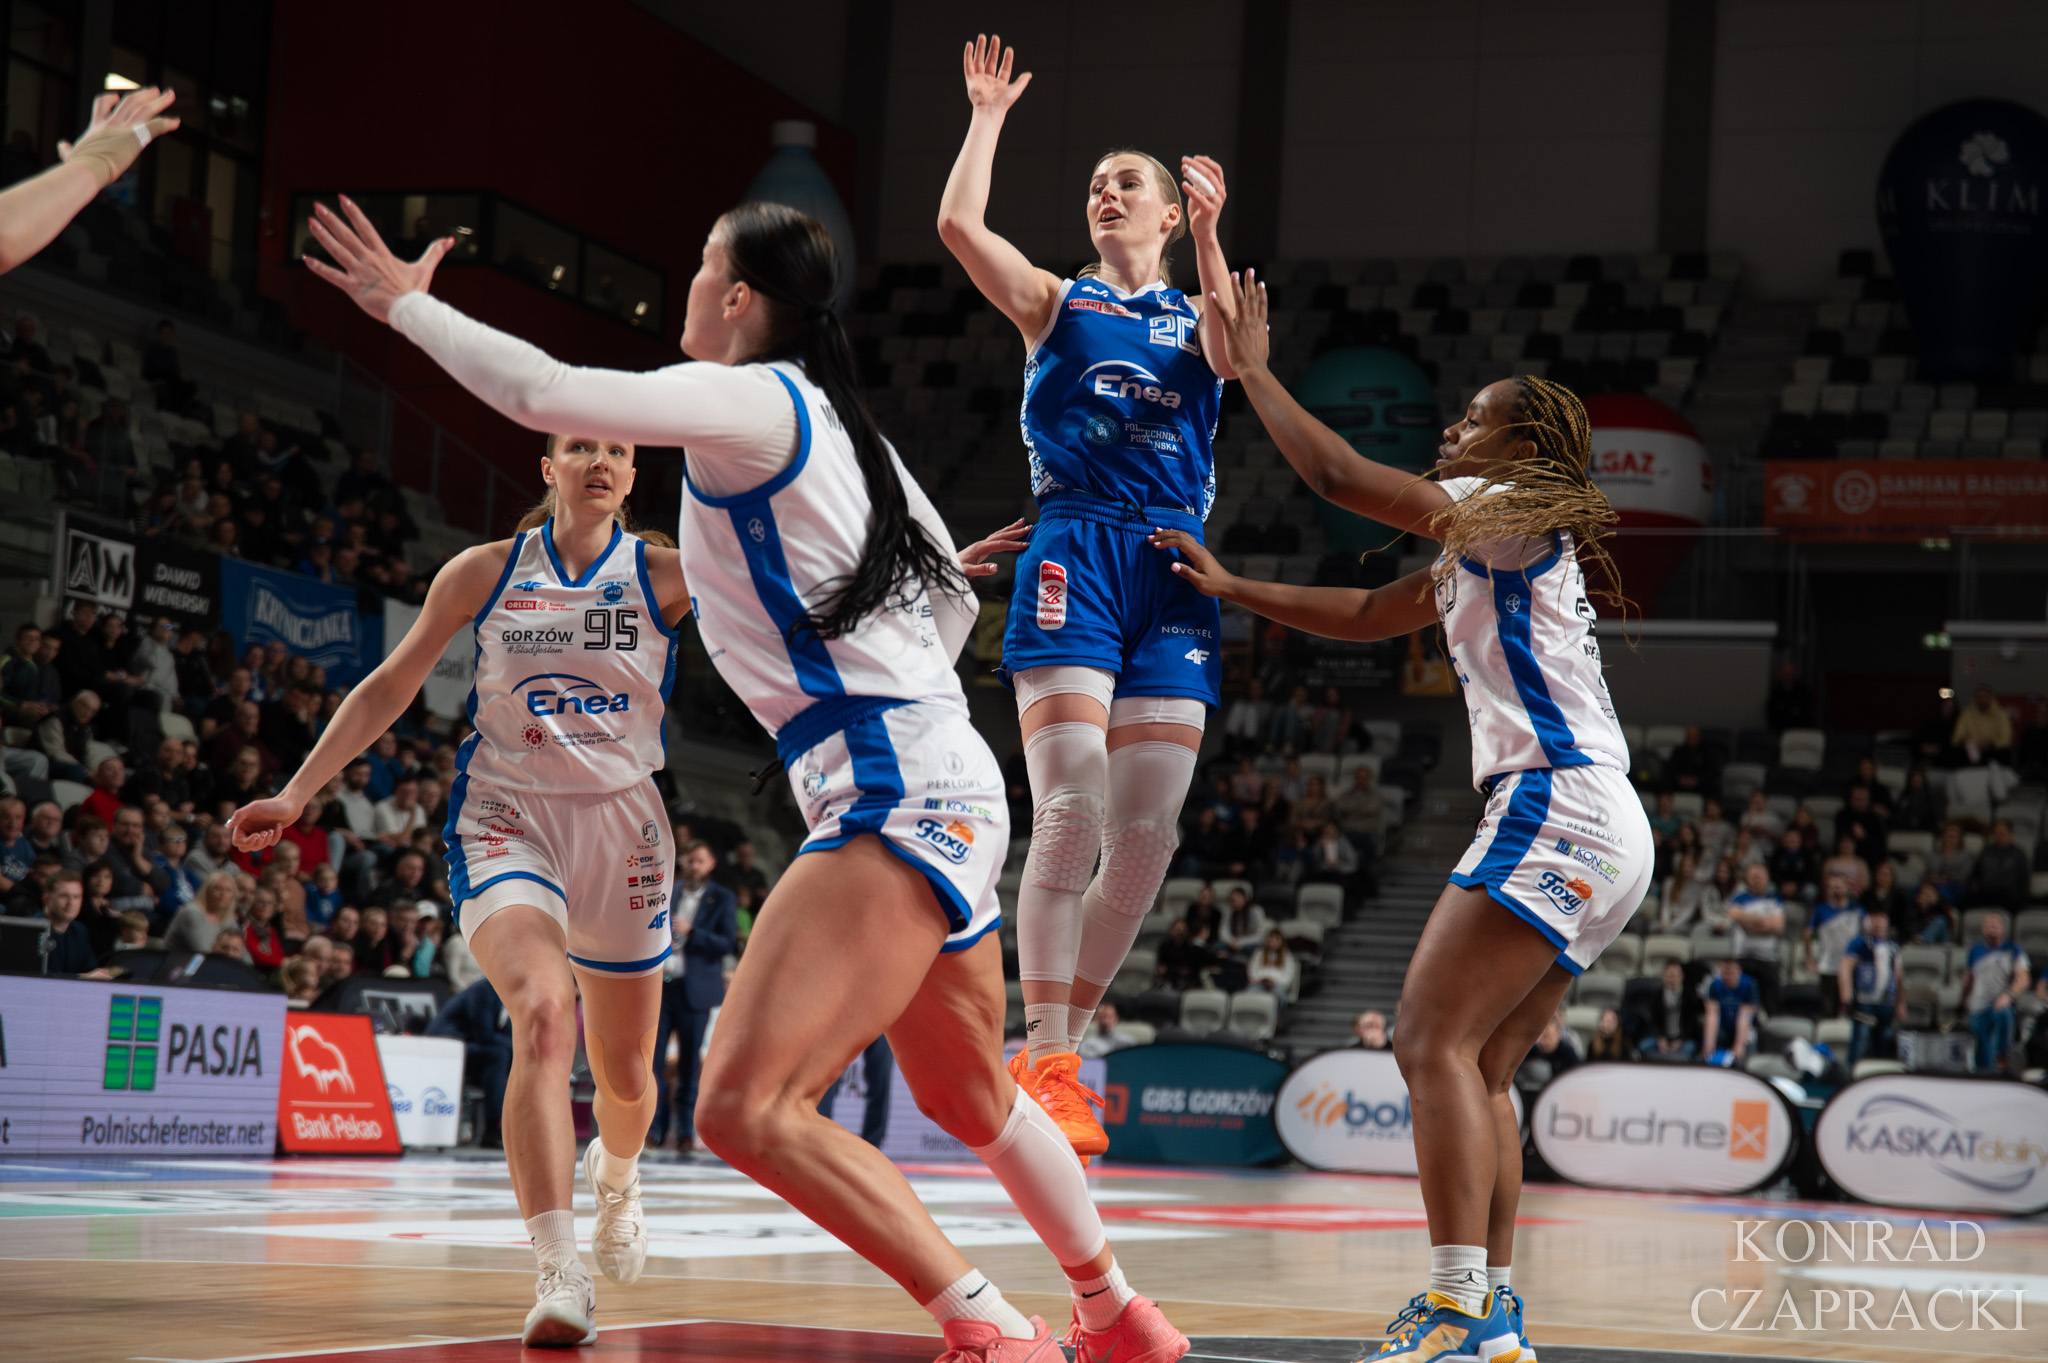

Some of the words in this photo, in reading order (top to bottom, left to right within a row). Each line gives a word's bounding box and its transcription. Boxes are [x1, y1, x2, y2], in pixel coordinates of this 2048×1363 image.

[1925, 178, 2039, 215] KLIM
[1094, 374, 1182, 409] Enea
[1879, 474, 1960, 495] DAMIAN
[154, 562, 201, 591] DAWID
[256, 588, 353, 650] KRYNICZANKA
[506, 601, 534, 609] ORLEN
[501, 627, 574, 643] GORZÓW
[584, 609, 639, 651] 95
[1161, 626, 1212, 639] NOVOTEL
[527, 690, 630, 717] Enea
[916, 819, 969, 859] Foxy
[1576, 847, 1620, 880] KONCEPT
[1538, 872, 1582, 911] Foxy
[166, 1022, 263, 1077] PASJA
[1141, 1088, 1186, 1113] GBS
[81, 1116, 266, 1147] Polnischefenster.net
[292, 1112, 332, 1139] Bank
[333, 1114, 383, 1140] Pekao
[1548, 1102, 1765, 1155] budnex
